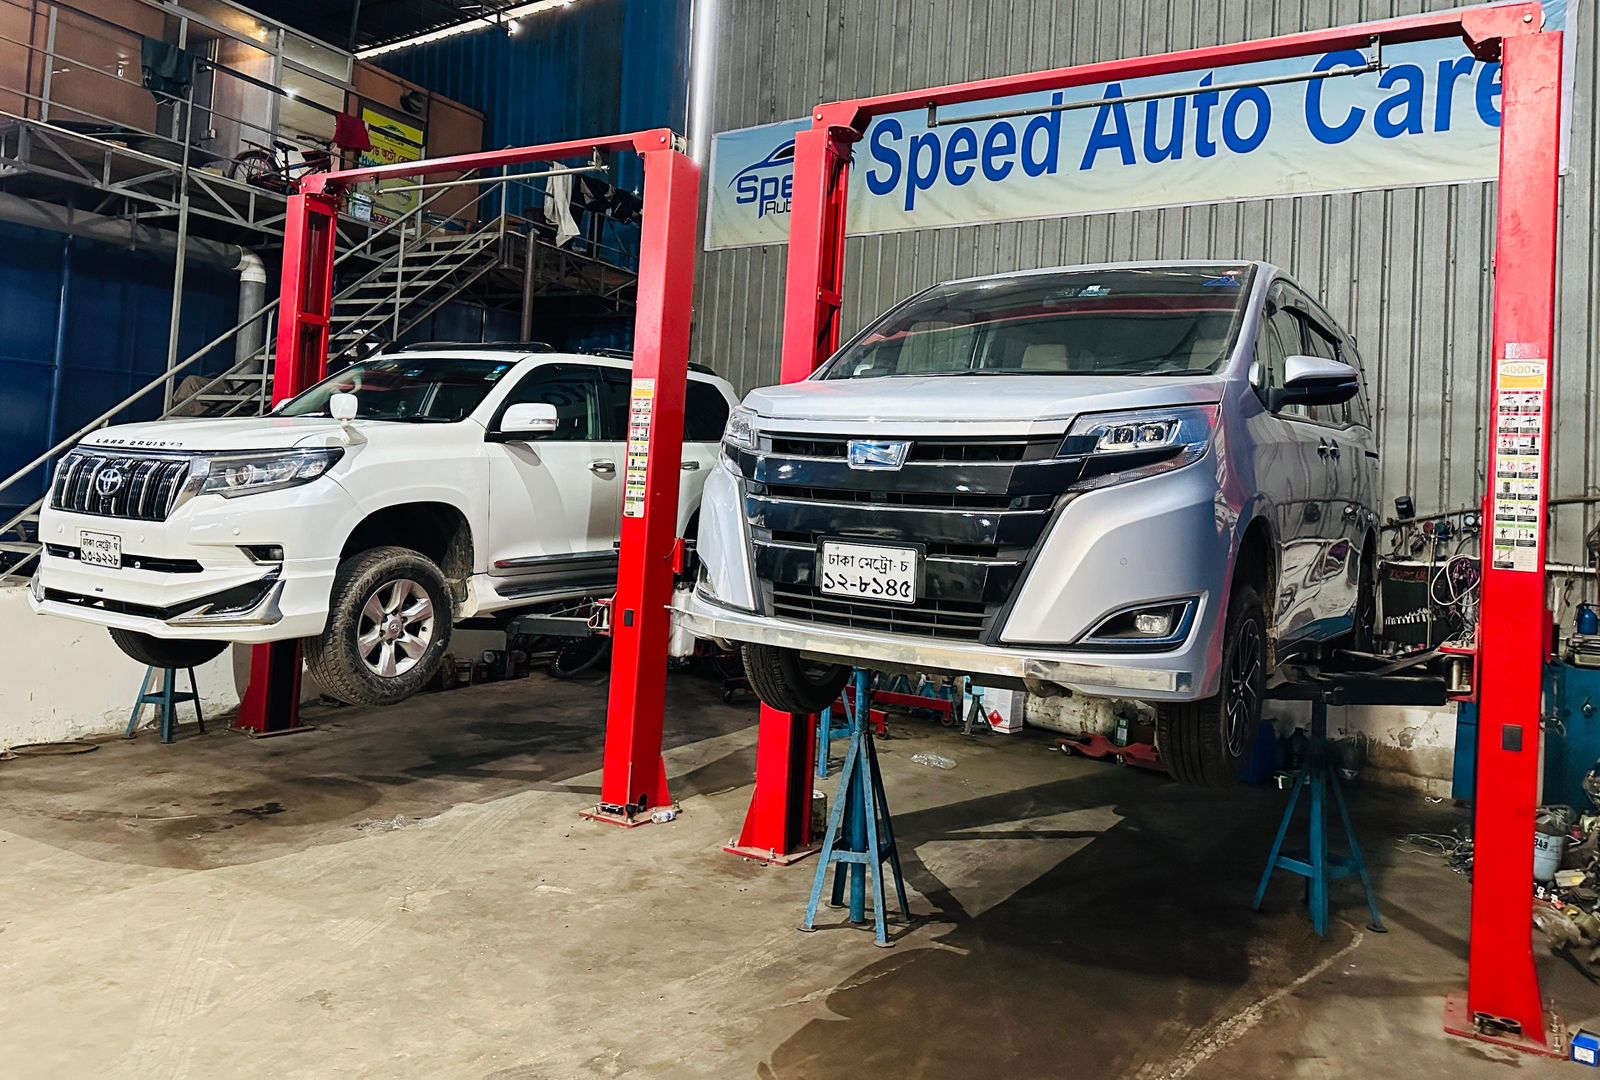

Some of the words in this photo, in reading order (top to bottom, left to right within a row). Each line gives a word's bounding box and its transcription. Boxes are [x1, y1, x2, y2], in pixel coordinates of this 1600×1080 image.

[866, 91, 1064, 211] Speed
[1079, 70, 1272, 171] Auto
[1305, 49, 1502, 145] Care
[736, 174, 793, 219] Spe
[764, 198, 792, 215] Aut
[828, 554, 854, 567] ঢাকা
[823, 572, 912, 598] ১২-৮১৪৫
